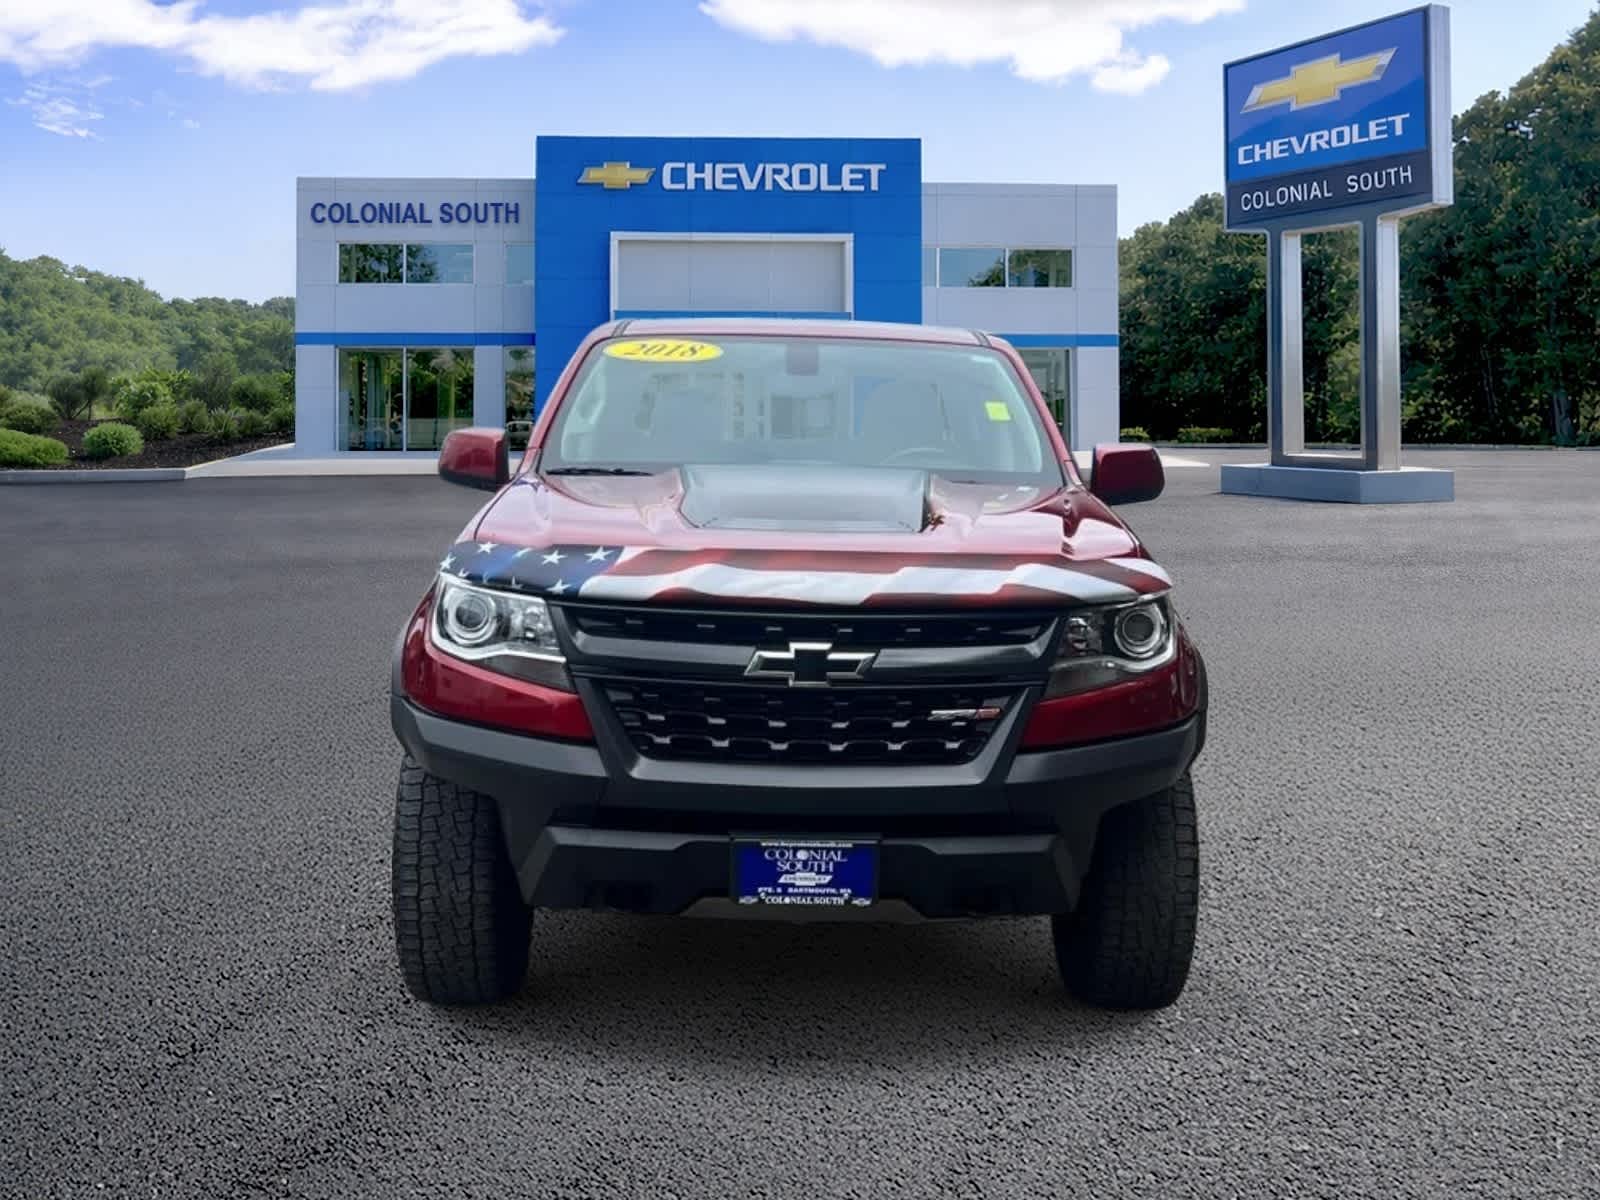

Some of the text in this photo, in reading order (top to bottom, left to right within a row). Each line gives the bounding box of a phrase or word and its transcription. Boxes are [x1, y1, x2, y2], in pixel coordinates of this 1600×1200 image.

[1238, 113, 1410, 165] CHEVROLET
[661, 162, 887, 192] CHEVROLET
[1240, 165, 1413, 211] COLONIAL SOUTH
[310, 202, 520, 224] COLONIAL SOUTH
[622, 343, 704, 358] 2018
[764, 849, 848, 862] COLONIAL
[776, 860, 834, 873] SOUTH
[765, 896, 845, 905] COLONIAL SOUTH
